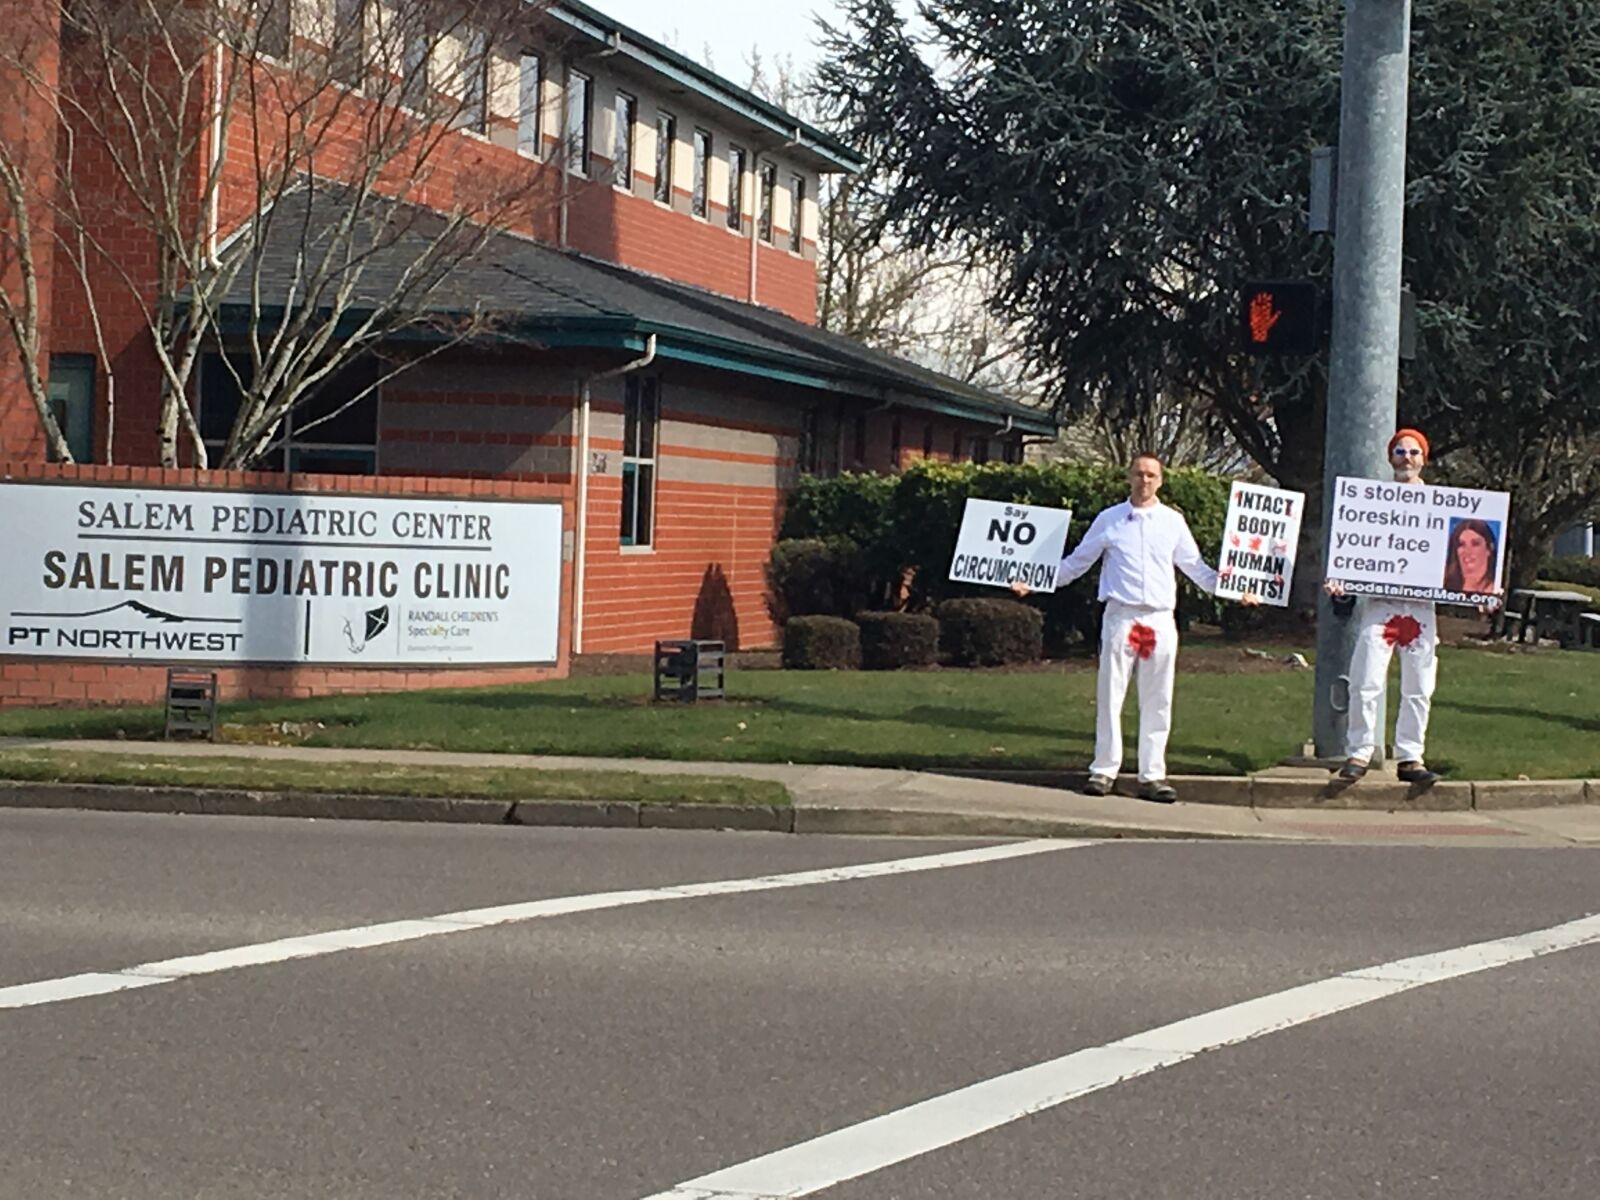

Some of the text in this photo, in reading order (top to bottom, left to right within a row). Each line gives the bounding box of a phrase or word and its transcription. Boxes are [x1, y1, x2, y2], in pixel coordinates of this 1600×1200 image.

[1237, 490, 1294, 517] INTACT
[1340, 481, 1482, 514] Is stolen baby
[78, 500, 492, 541] SALEM PEDIATRIC CENTER
[1004, 506, 1029, 520] Say
[1338, 505, 1445, 530] foreskin in
[987, 519, 1037, 546] NO
[1237, 515, 1286, 540] BODY!
[1001, 545, 1015, 556] to
[1336, 531, 1430, 553] your face
[43, 550, 510, 600] SALEM PEDIATRIC CLINIC
[953, 553, 1056, 589] CIRCUMCISION
[1227, 549, 1285, 576] HUMAN
[1333, 555, 1408, 575] cream?
[1219, 572, 1285, 600] RIGHTS!
[408, 610, 449, 622] RANDALL
[8, 628, 244, 652] PT NORTHWEST
[450, 625, 470, 637] Care
